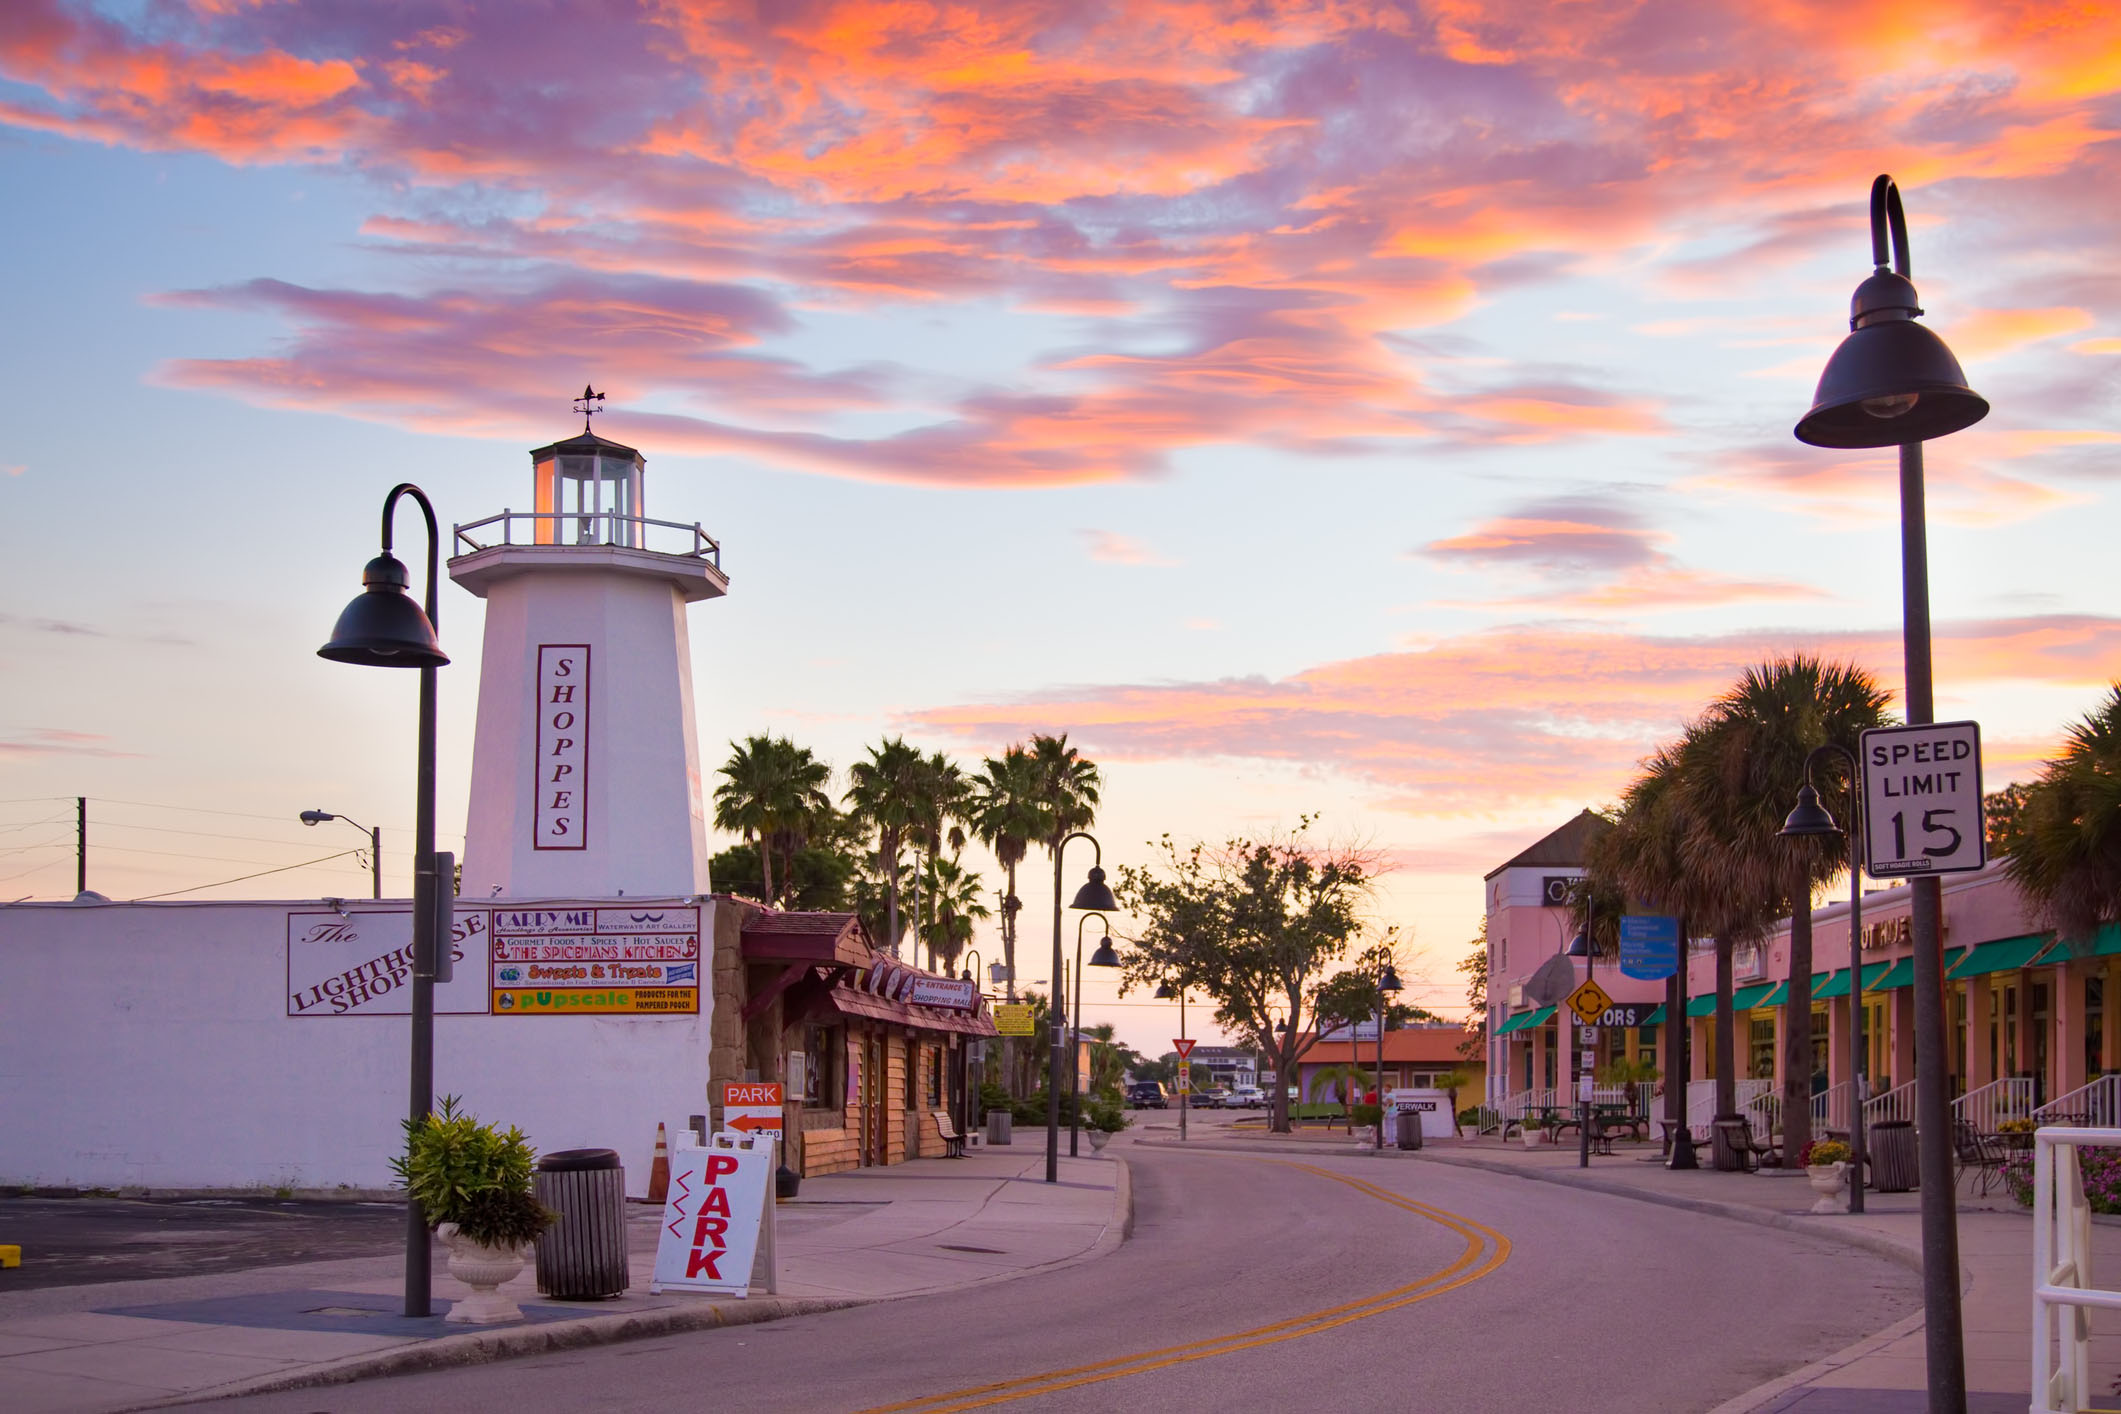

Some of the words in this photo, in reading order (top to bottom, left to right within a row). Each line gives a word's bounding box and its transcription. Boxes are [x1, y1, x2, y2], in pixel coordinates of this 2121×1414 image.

[550, 659, 576, 835] SHOPPES
[1872, 740, 1970, 766] SPEED
[1884, 772, 1961, 797] LIMIT
[1892, 809, 1962, 859] 15
[496, 912, 560, 927] CARRY
[564, 911, 593, 926] ME
[301, 923, 360, 943] The
[507, 938, 545, 946] GOURMET
[549, 937, 575, 945] FOODS
[591, 937, 617, 945] SPICES
[510, 947, 537, 959] THE
[624, 945, 681, 959] KITCHEN
[292, 914, 486, 1012] LIGHTHSE
[528, 964, 587, 980] Sweets
[591, 964, 605, 979] &
[608, 963, 662, 980] Treats
[330, 944, 465, 1014] SHOPS
[926, 981, 962, 992] ENTRANCE
[520, 991, 629, 1009] pUpscale
[679, 990, 691, 998] THE
[913, 994, 952, 1003] SHOPPING
[953, 997, 972, 1006] MALL
[636, 1001, 668, 1009] PAMPERED
[669, 1001, 690, 1009] POOCH
[1572, 1008, 1636, 1026] GORS
[1585, 1028, 1593, 1038] 5
[728, 1087, 776, 1102] PARK
[685, 1155, 739, 1280] PARK
